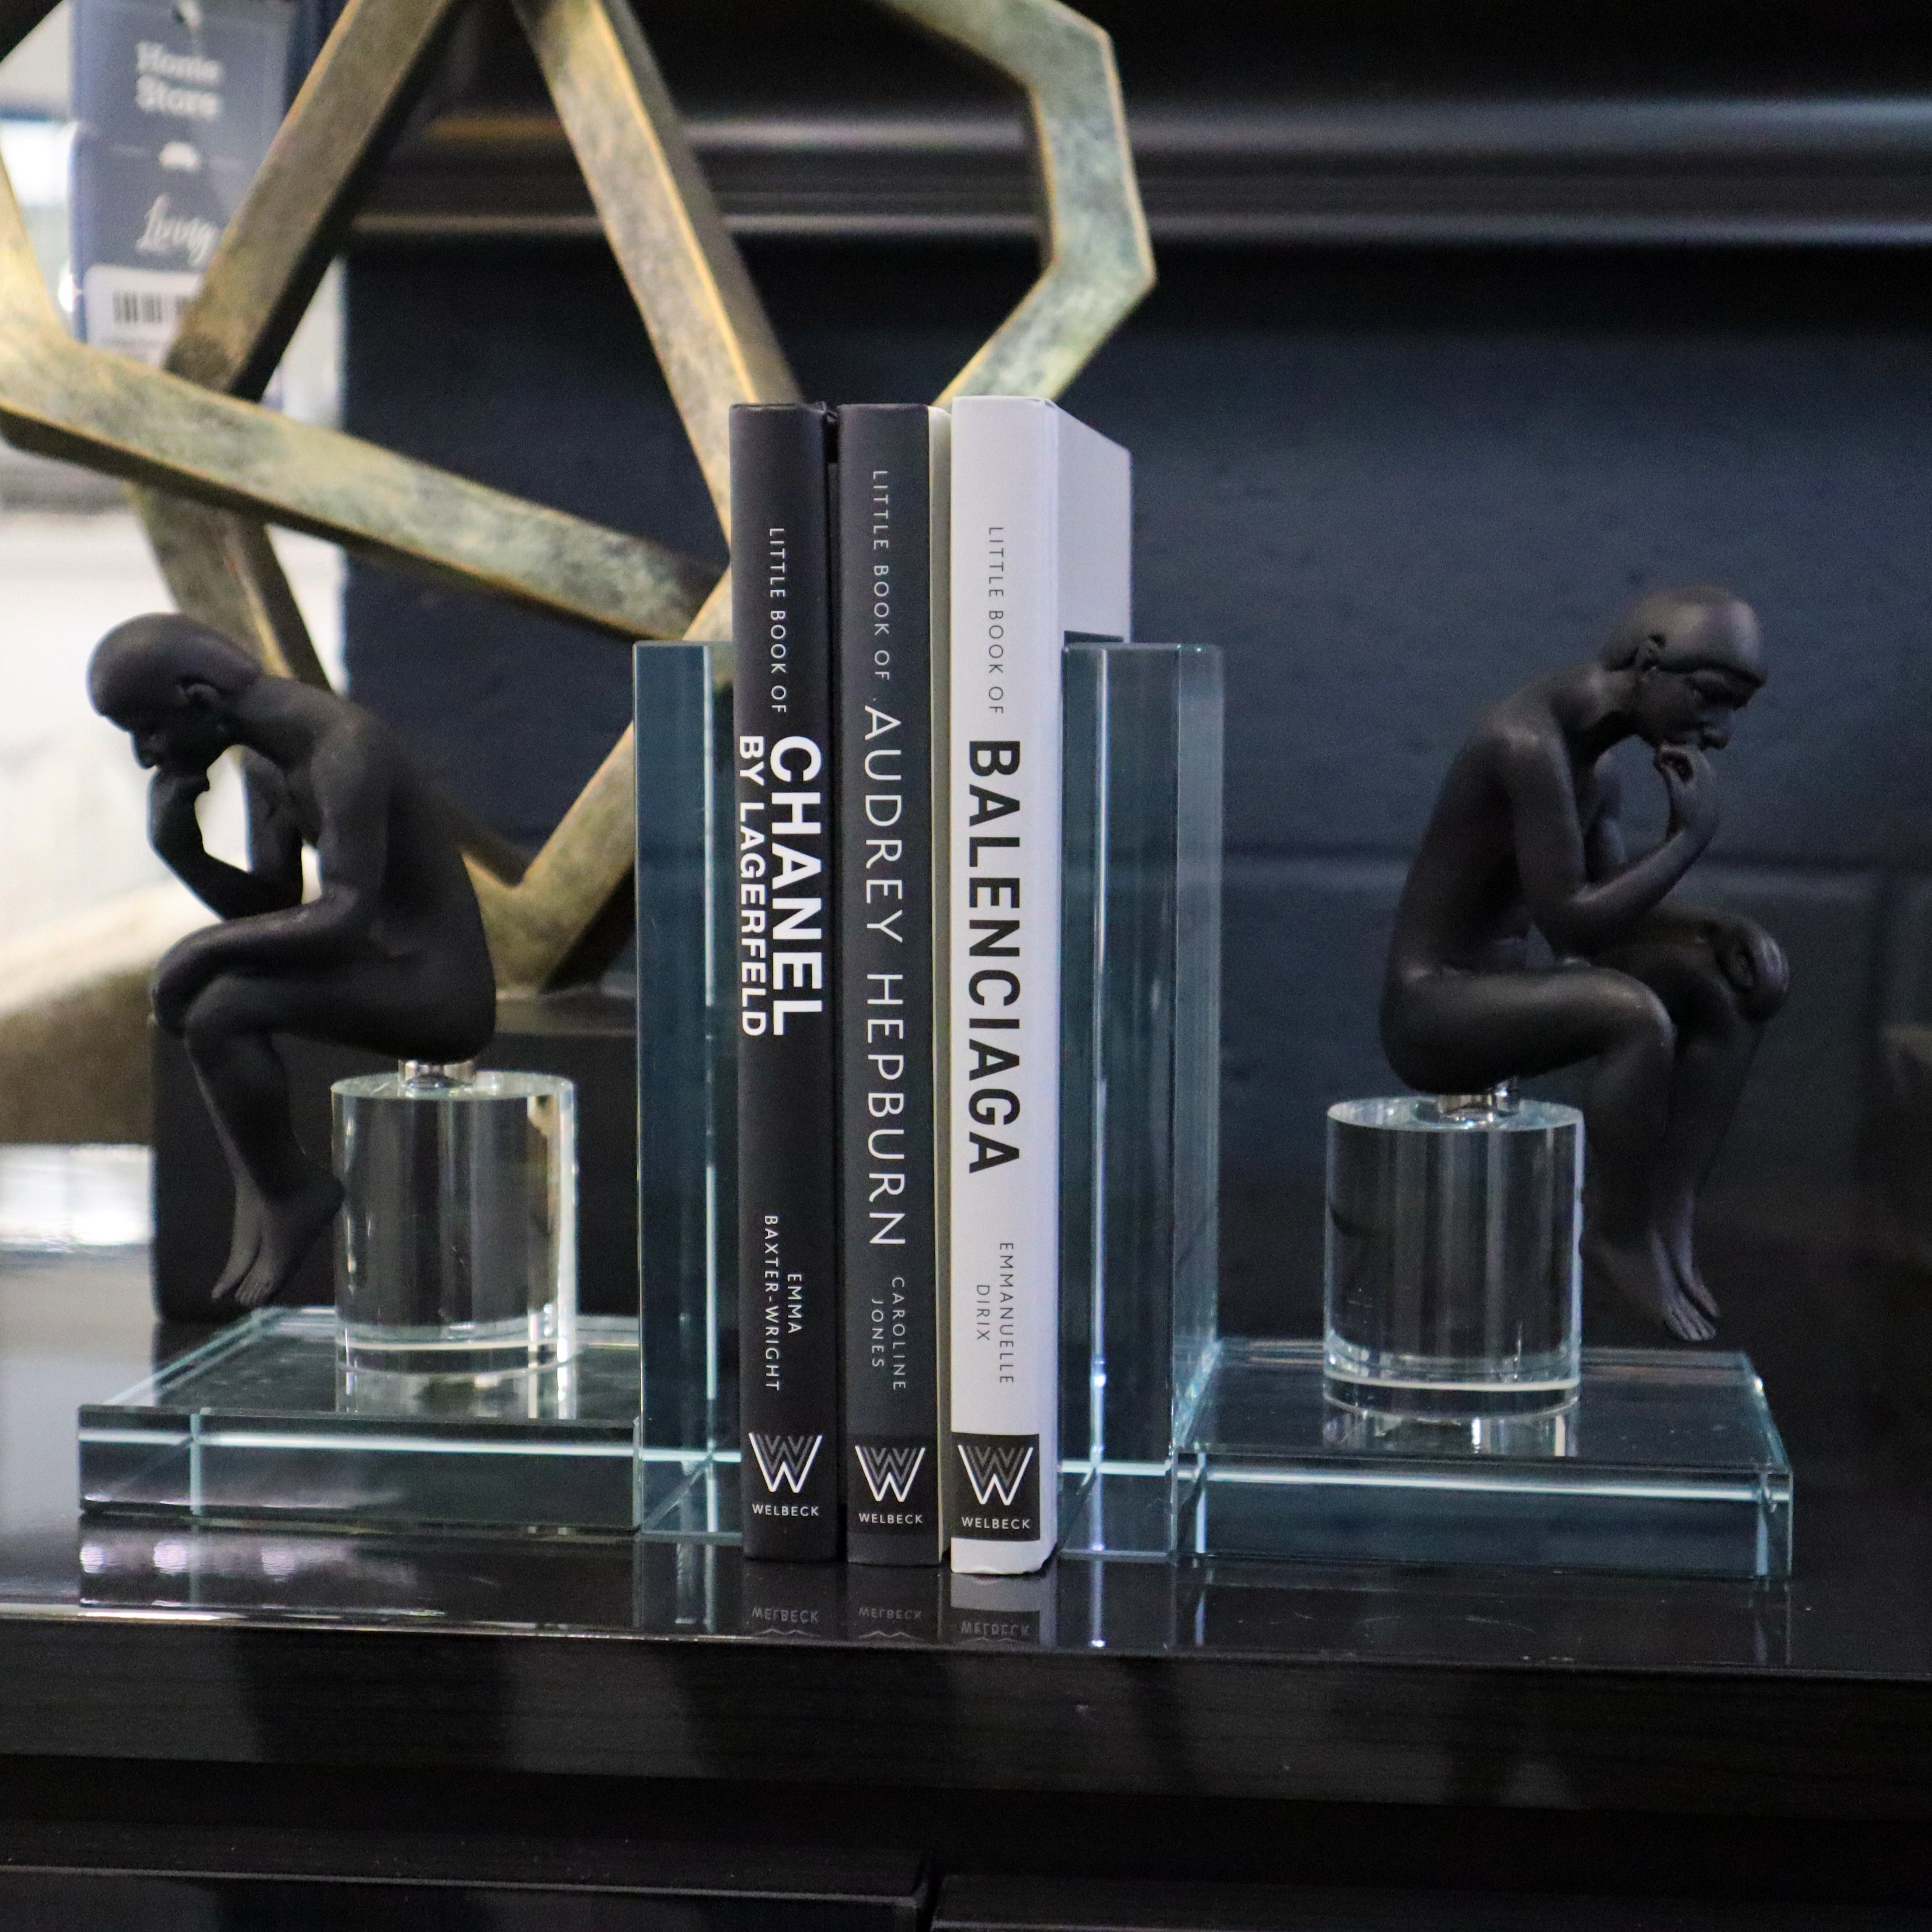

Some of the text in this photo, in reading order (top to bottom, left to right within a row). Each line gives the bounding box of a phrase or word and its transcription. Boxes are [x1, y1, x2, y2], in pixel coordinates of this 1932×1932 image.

[769, 528, 823, 1035] LITTLE BOOK OF CHANEL
[739, 736, 767, 1036] BY LAGERFELD
[864, 470, 906, 1244] LITTLE BOOK OF AUDREY HEPBURN
[969, 527, 1021, 1174] LITTLE BOOK OF BALENCIAGA
[764, 1215, 779, 1391] BAXTER-WRIGHT
[787, 1273, 802, 1333] EMMA
[871, 1298, 884, 1367] JONES
[892, 1276, 906, 1390] CAROLINE
[977, 1284, 991, 1341] DIRIX
[999, 1243, 1014, 1383] EMMANUELLE
[752, 1503, 819, 1516] WELBECK
[858, 1512, 923, 1524] WELBECK
[961, 1516, 1030, 1530] WELBECK
